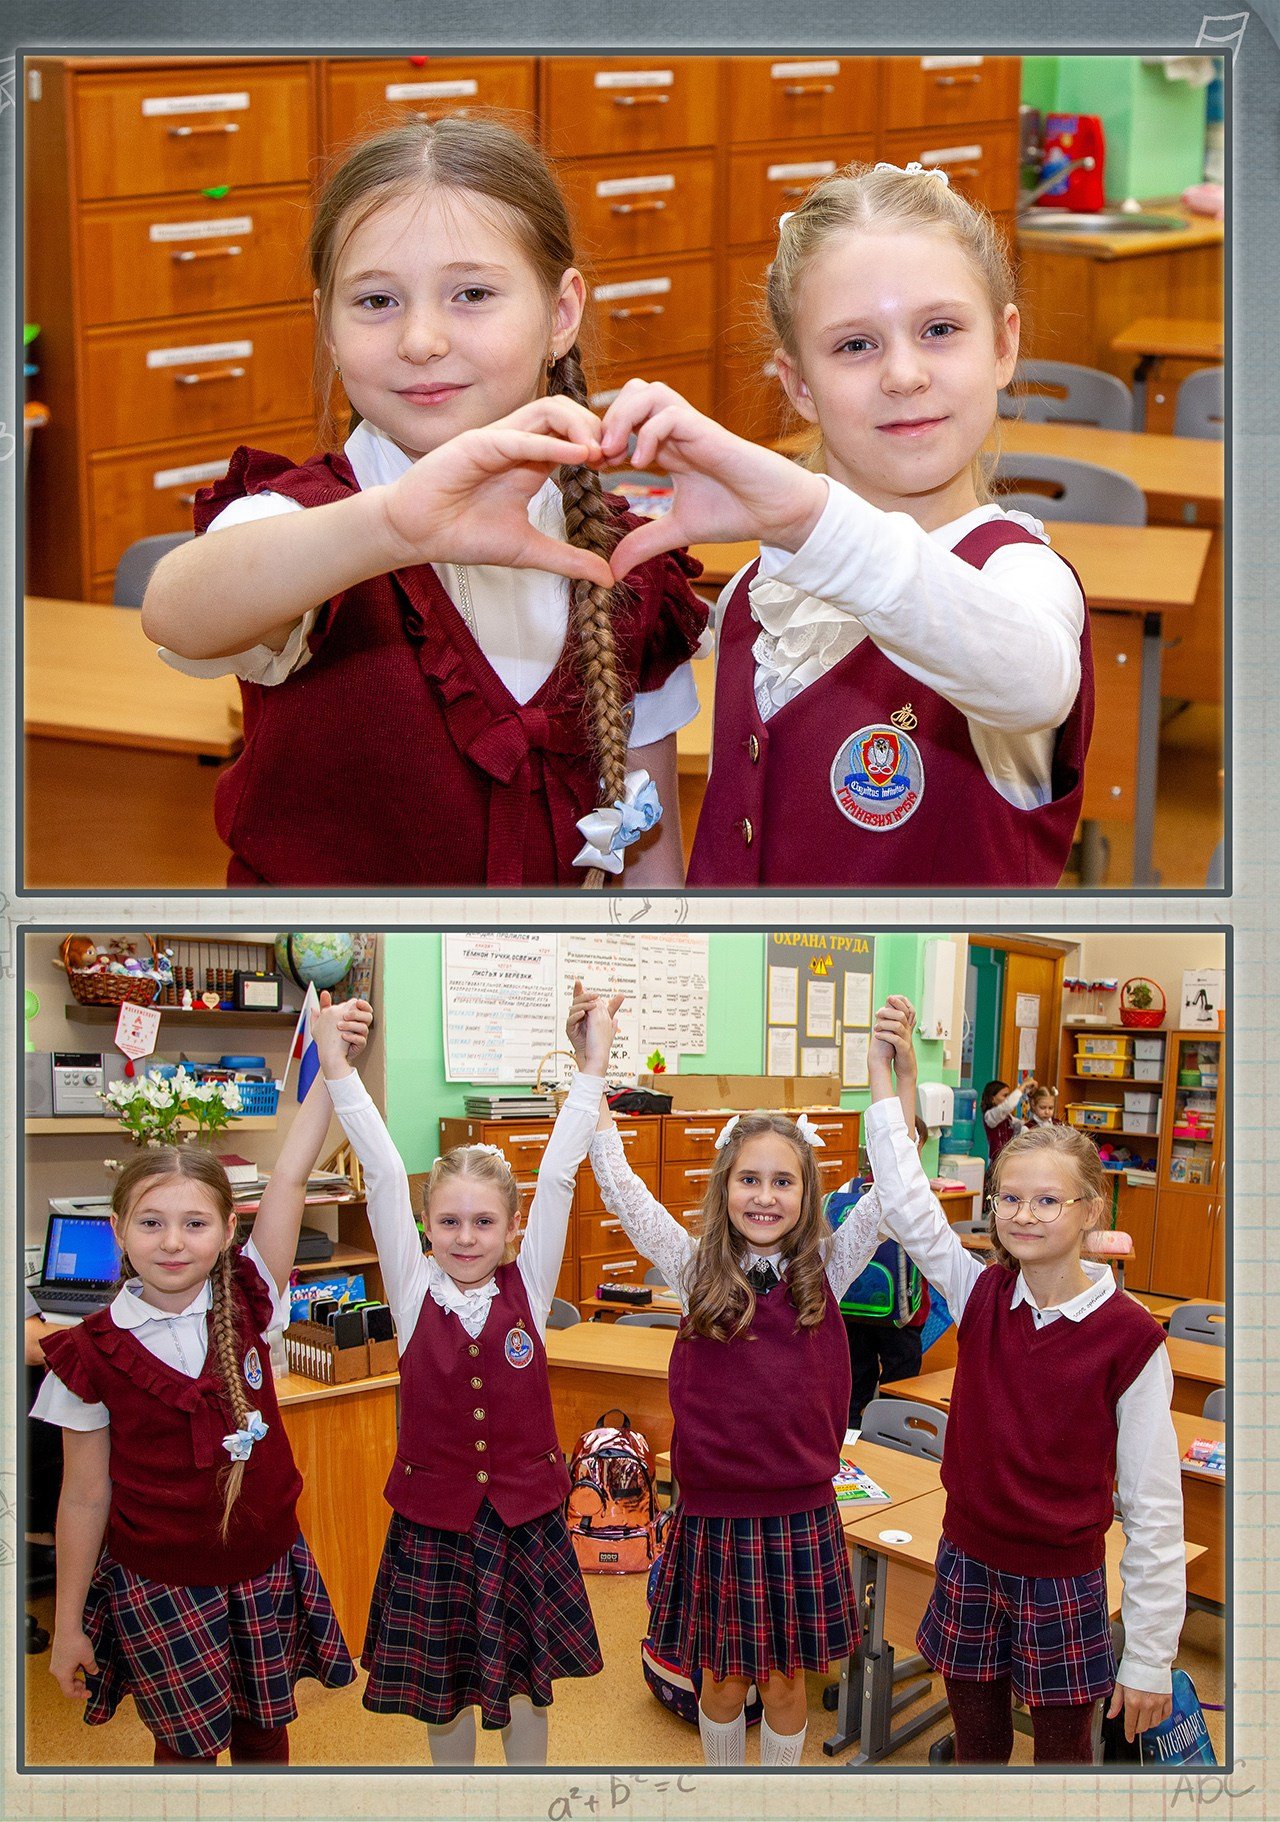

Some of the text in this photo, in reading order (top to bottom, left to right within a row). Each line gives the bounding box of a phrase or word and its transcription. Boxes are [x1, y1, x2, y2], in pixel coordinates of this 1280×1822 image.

[838, 786, 892, 826] ГИМНАЗИЯ
[773, 932, 869, 954] ОХРАНА ТРУДА
